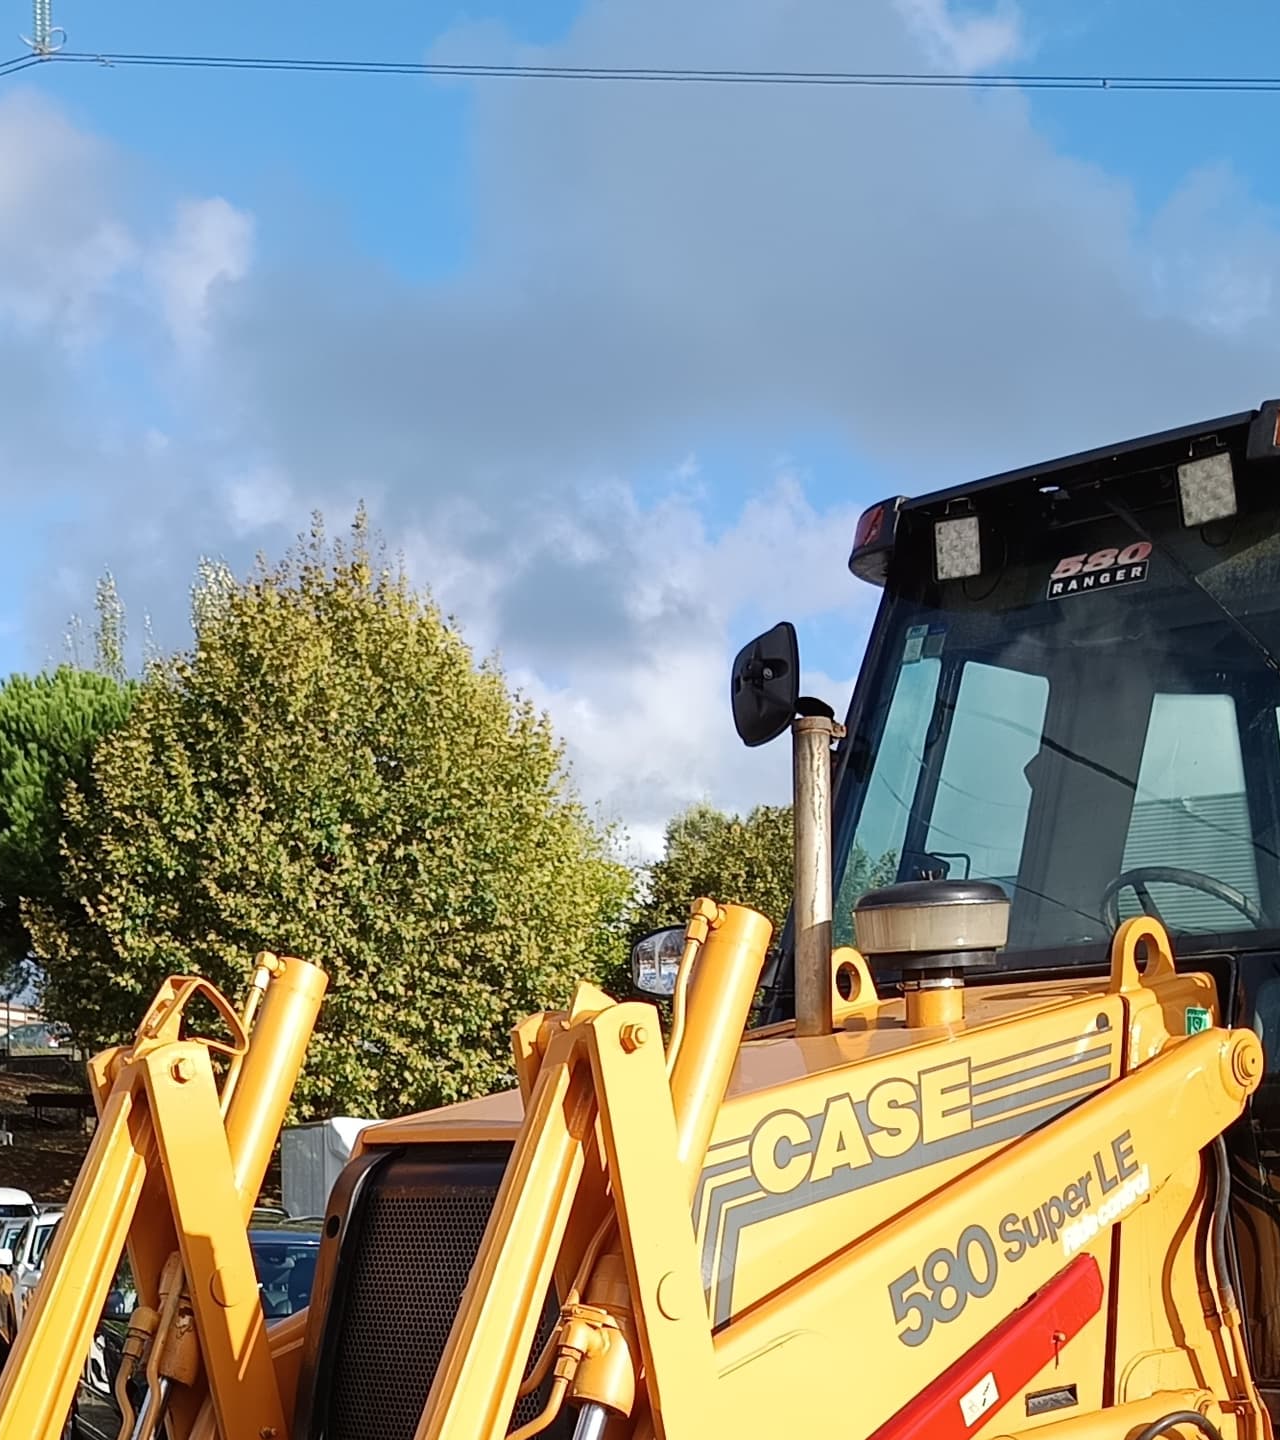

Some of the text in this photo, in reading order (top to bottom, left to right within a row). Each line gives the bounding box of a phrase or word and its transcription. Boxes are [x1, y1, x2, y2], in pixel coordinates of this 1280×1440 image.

[1050, 541, 1152, 579] 580
[1052, 566, 1142, 594] RANGER
[749, 1057, 973, 1195] CASE
[888, 1129, 1139, 1347] 580 Super LE
